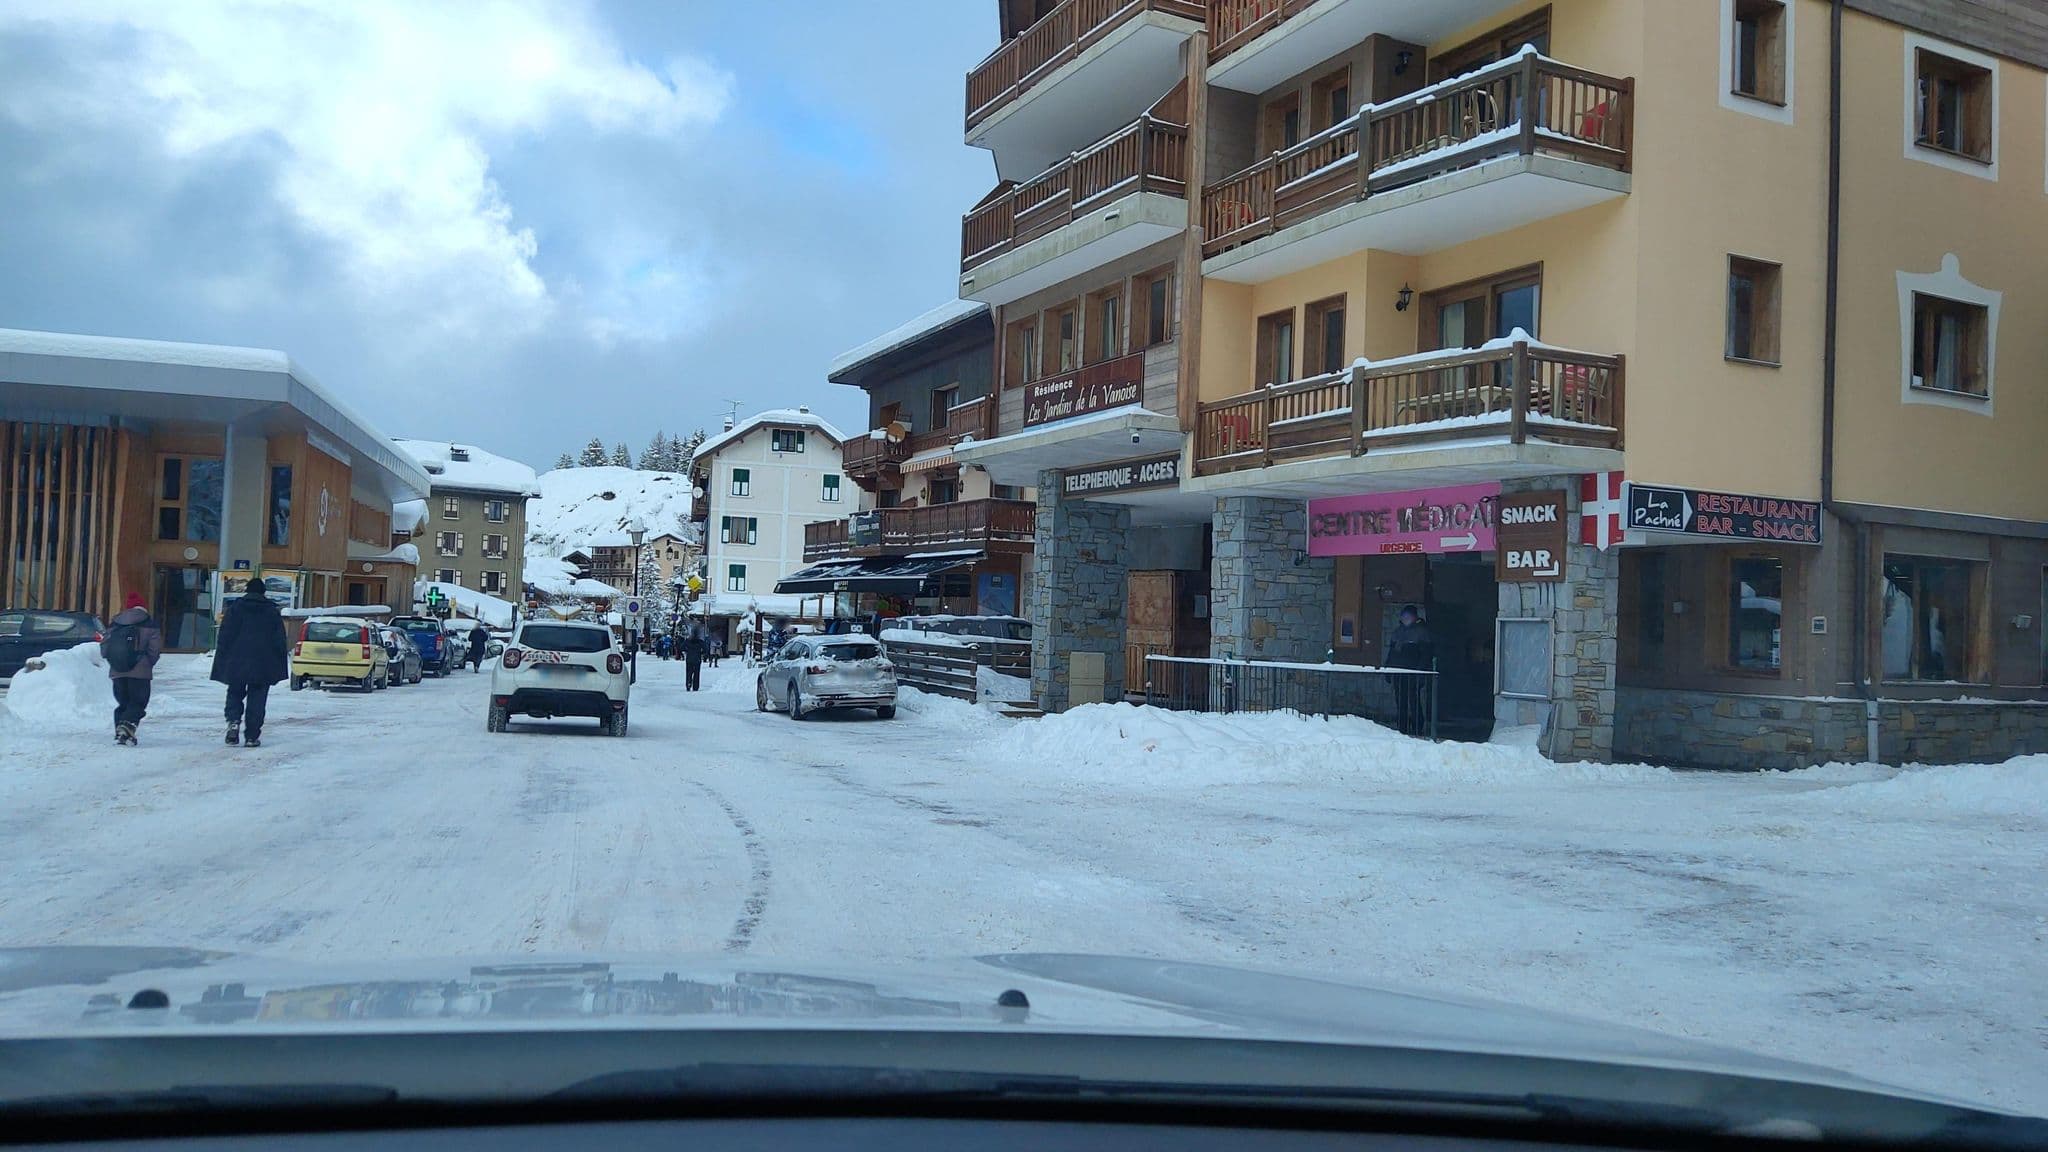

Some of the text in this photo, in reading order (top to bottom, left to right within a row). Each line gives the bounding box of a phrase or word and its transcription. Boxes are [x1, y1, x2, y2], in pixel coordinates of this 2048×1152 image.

[1028, 382, 1137, 422] Les Jardins de la Vanoise
[1065, 467, 1132, 492] TELEPHERIQUE
[1139, 460, 1174, 483] ACCES
[1647, 491, 1669, 509] La
[1697, 493, 1817, 522] RESTAURANT
[1310, 500, 1497, 538] CENTRE MÉDICAL
[1501, 504, 1557, 524] SNACK
[1634, 507, 1682, 528] Pachné
[1697, 515, 1734, 535] BAR
[1752, 518, 1817, 542] SNACK
[1379, 542, 1423, 554] URGENCE
[1506, 550, 1551, 568] BAR
[850, 624, 864, 633] GO
